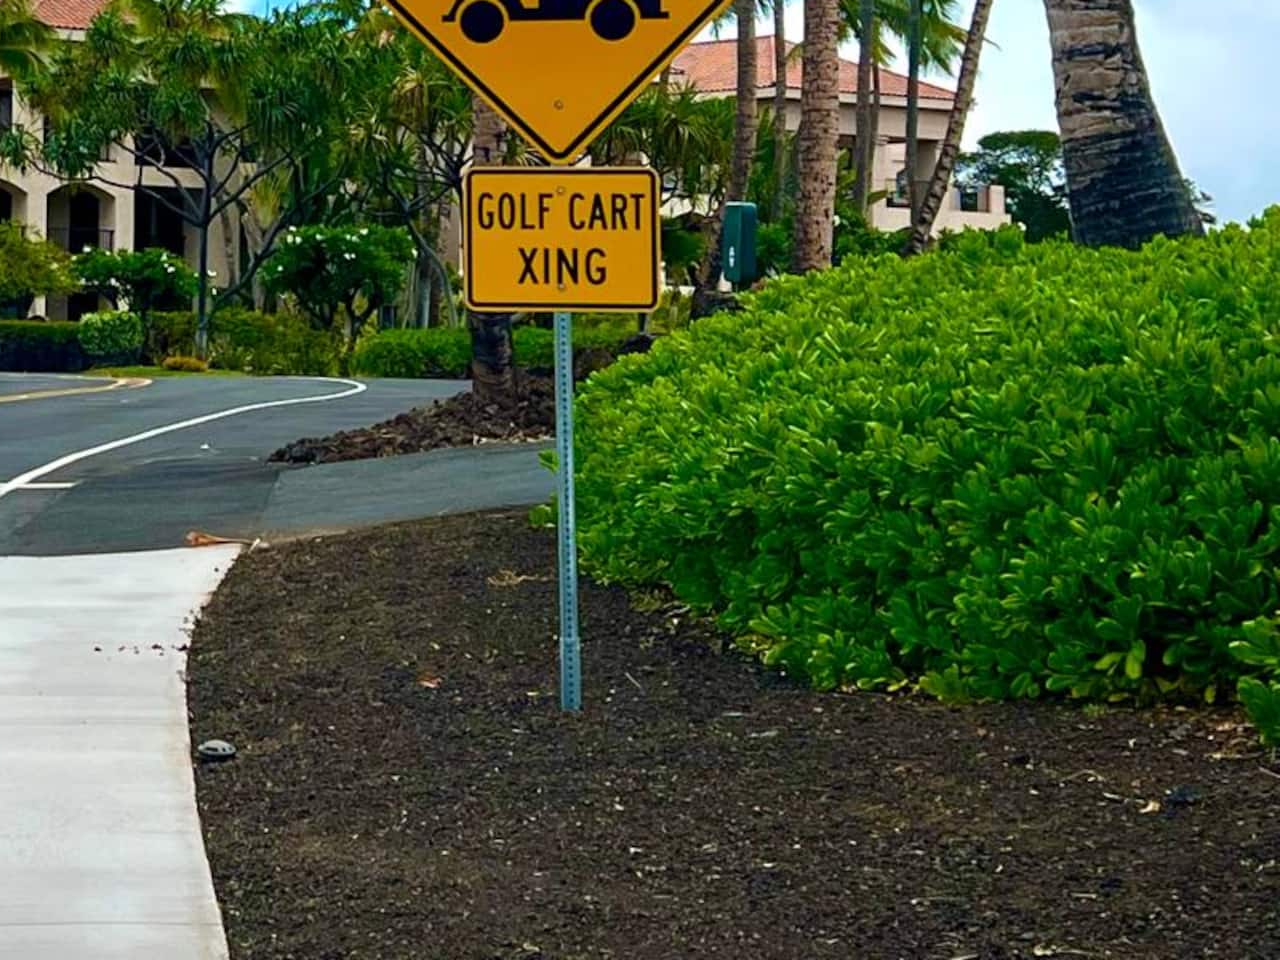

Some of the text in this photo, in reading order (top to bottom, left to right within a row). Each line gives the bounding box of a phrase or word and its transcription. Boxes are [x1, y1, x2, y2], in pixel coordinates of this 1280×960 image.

[478, 192, 645, 230] GOLF CART
[518, 247, 607, 285] XING
